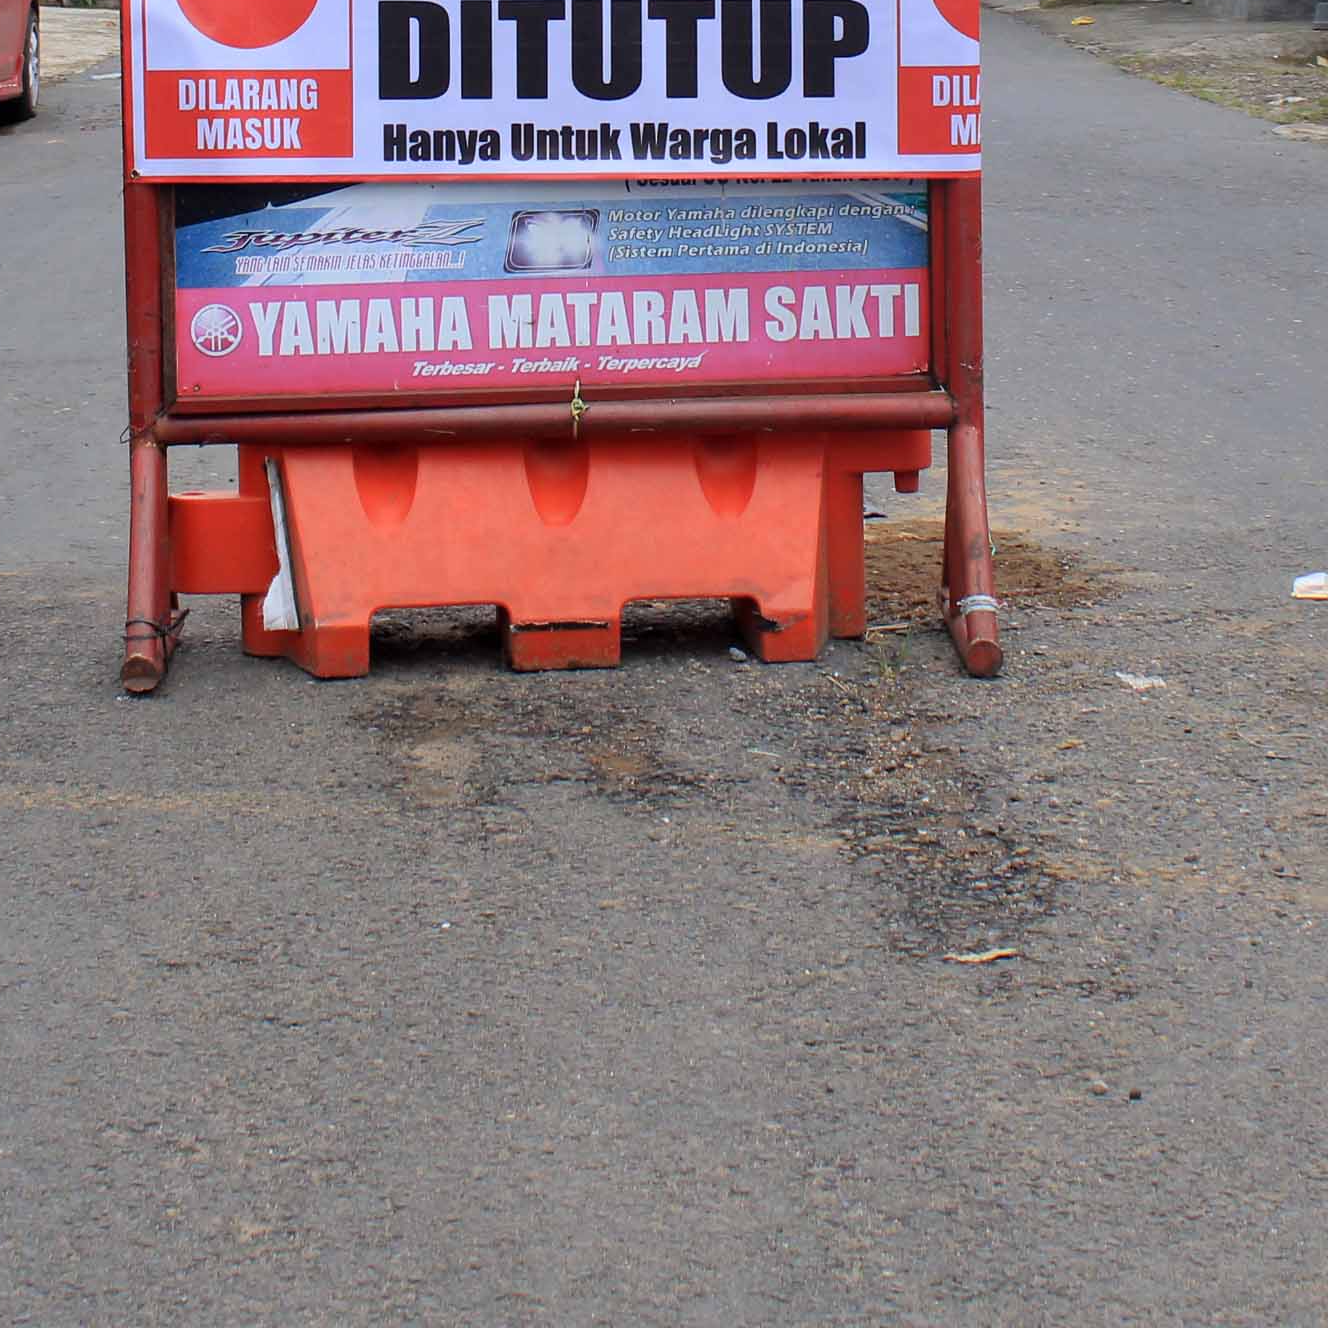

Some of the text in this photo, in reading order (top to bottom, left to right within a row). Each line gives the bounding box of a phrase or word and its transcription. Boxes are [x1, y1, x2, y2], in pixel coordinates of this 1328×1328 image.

[178, 79, 319, 110] DILARANG
[197, 118, 301, 150] MASUK
[383, 121, 867, 165] Hanya Untuk Warga Lokal
[608, 208, 660, 223] Motor
[666, 206, 736, 221] Yamaha
[740, 203, 834, 221] dilengkapi
[608, 222, 833, 243] Safety HeadLight SYSTEM
[608, 238, 869, 261] (Sistem Pertama di Indonesia)
[236, 255, 264, 273] YANG
[265, 254, 290, 271] LAIN
[292, 254, 342, 271] SEMAKIN
[345, 253, 378, 270] JELAS
[248, 283, 920, 357] YAMAHA MATARAM SAKTI
[412, 361, 495, 377] Terbesar
[510, 357, 579, 373] Terbaik
[597, 354, 703, 373] Terpercaya
